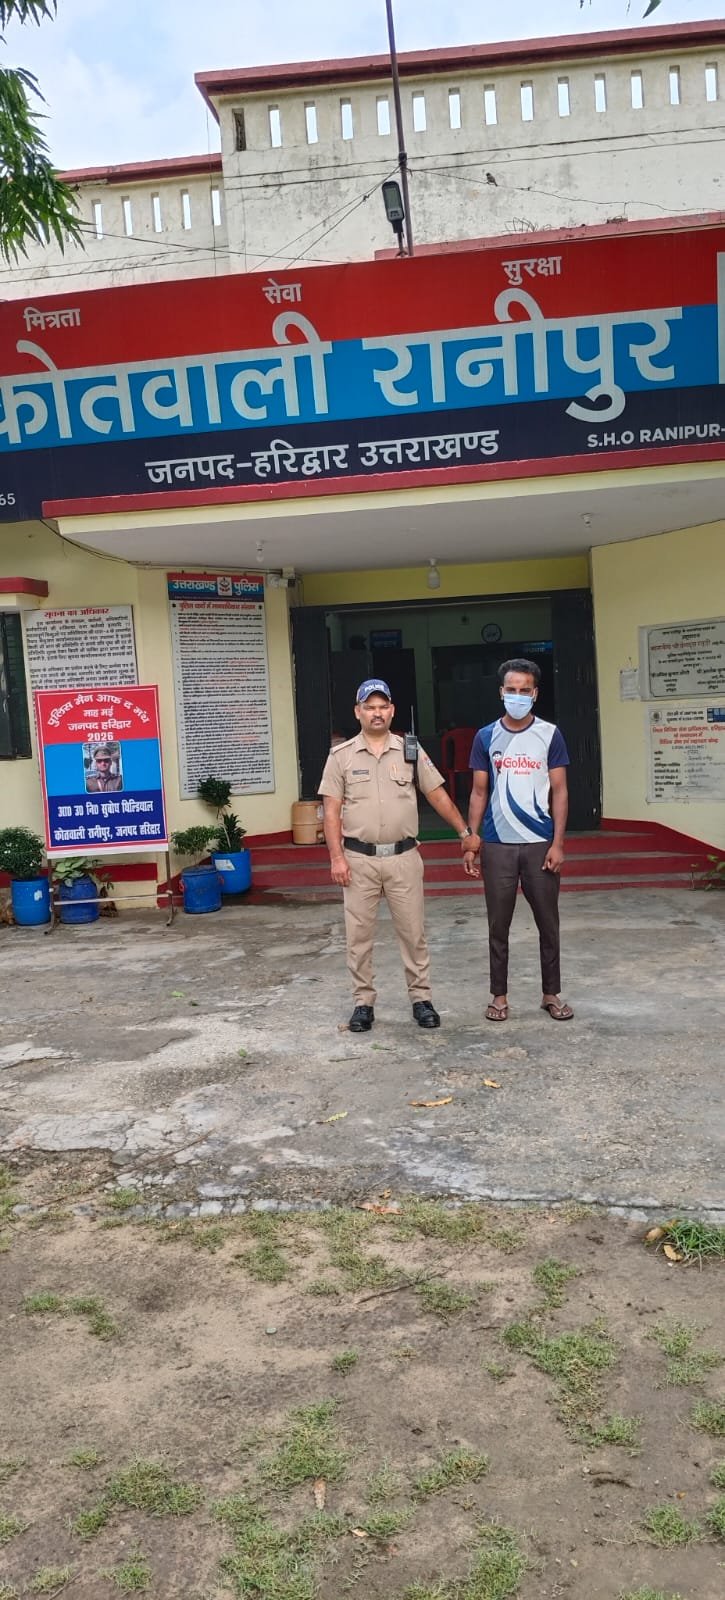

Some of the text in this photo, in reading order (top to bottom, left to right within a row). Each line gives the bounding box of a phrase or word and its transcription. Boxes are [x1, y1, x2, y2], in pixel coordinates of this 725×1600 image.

[501, 256, 562, 286] सुरक्षा
[262, 278, 302, 304] सेवा
[23, 306, 81, 332] मित्रता
[361, 287, 683, 423] रानीपुर
[358, 429, 500, 467] उत्तराखण्ड
[587, 430, 635, 448] S.H.O
[172, 578, 260, 596] उत्तराखण्ड पुलिस
[364, 683, 385, 692] POLICE
[47, 701, 73, 728] पुलिस
[123, 700, 134, 709] द
[83, 705, 114, 718] माह मई
[67, 718, 132, 732] जनपद हरिद्वार
[87, 732, 114, 743] 2026
[503, 757, 542, 769] Goldiee
[54, 825, 86, 841] कोतवाली
[114, 825, 138, 838] जनपद
[139, 821, 161, 836] हरिद्वार
